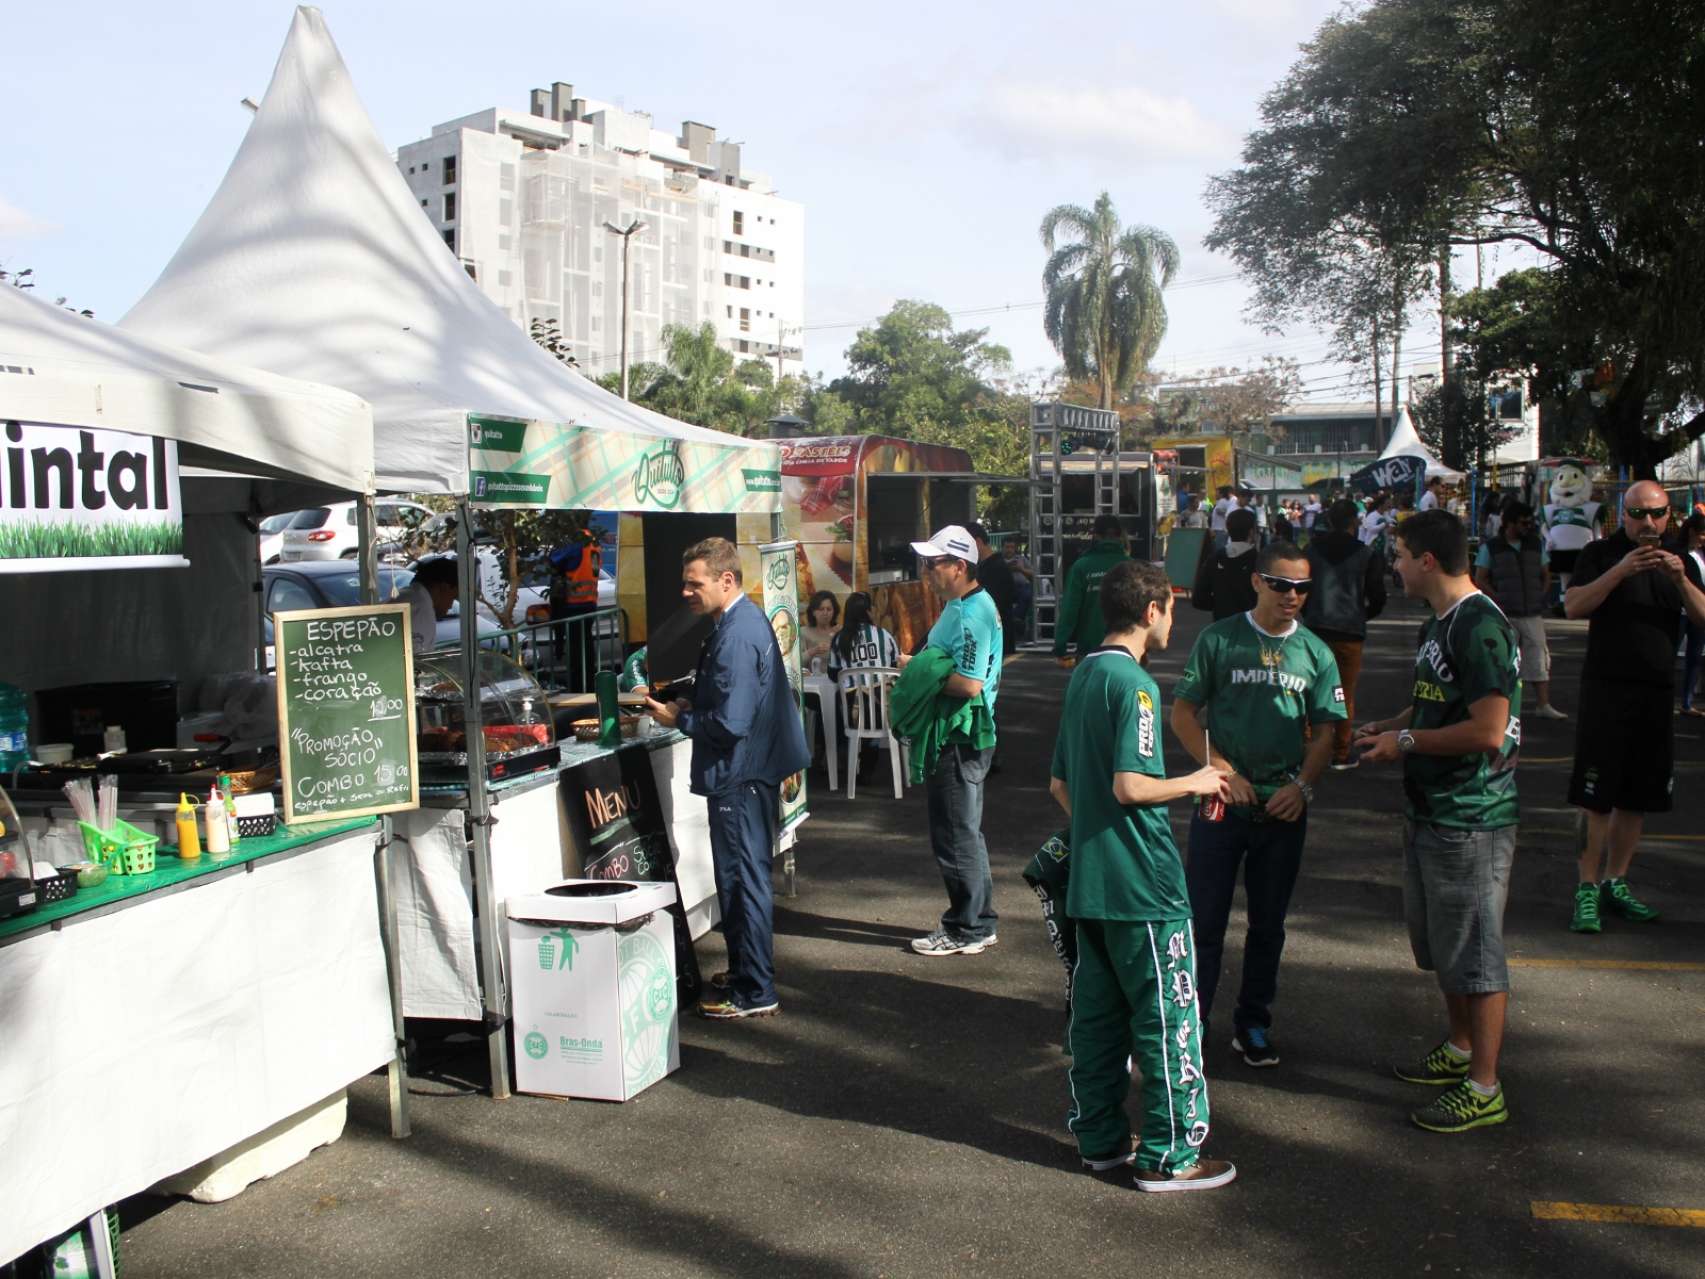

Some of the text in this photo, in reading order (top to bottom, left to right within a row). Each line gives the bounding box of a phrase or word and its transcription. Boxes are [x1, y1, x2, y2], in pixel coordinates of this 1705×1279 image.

[0, 421, 168, 511] intal
[307, 617, 396, 641] ESPEPÃO
[298, 774, 365, 798] COMBO
